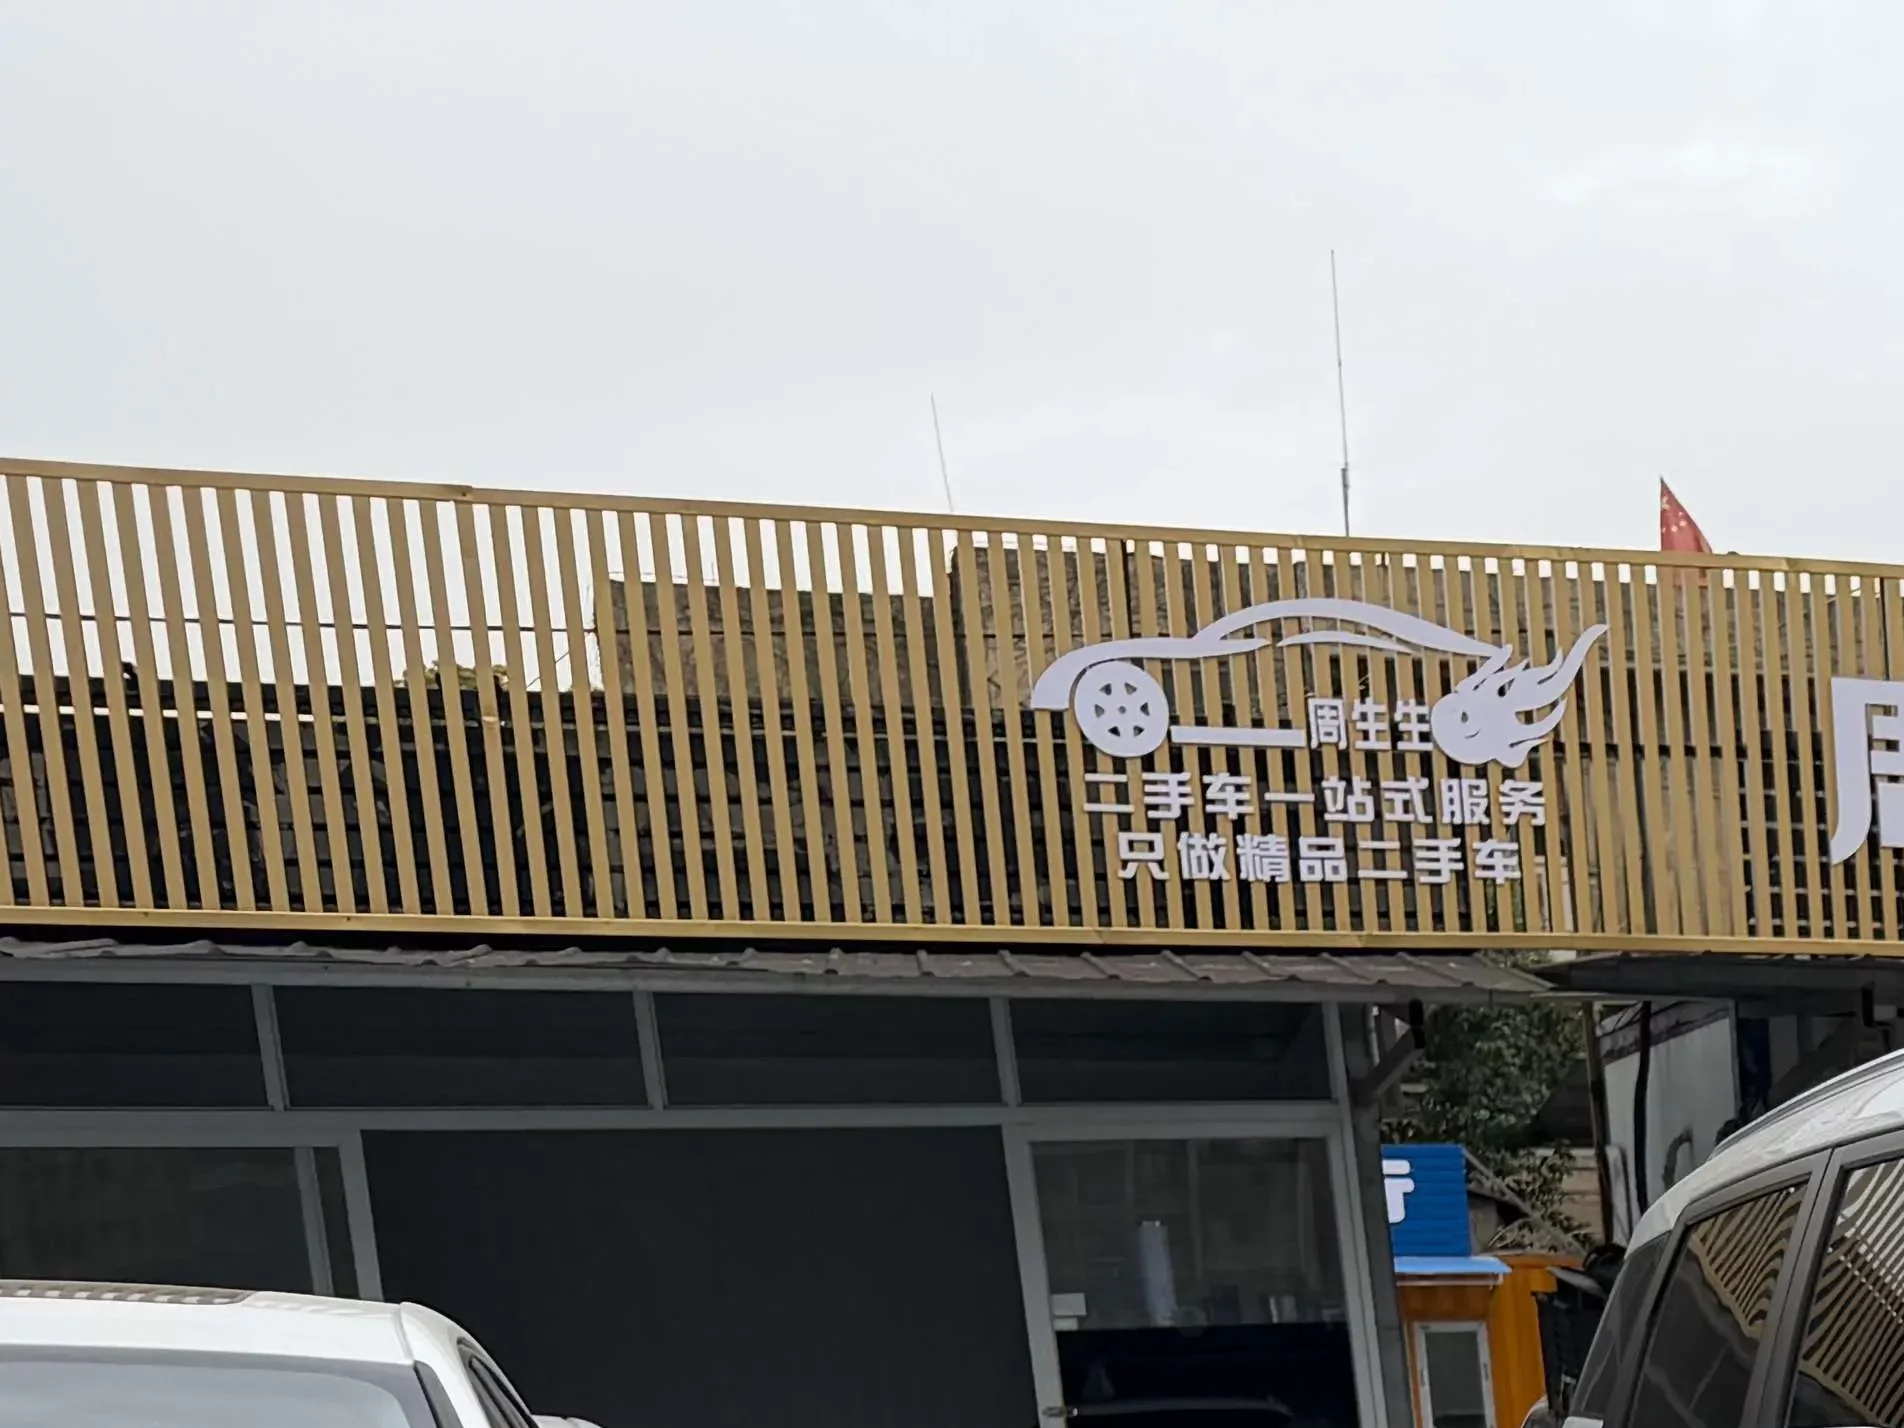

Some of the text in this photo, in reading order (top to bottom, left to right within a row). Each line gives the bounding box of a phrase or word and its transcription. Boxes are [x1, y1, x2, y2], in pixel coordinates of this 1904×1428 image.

[1307, 697, 1431, 752] 周生生
[1083, 771, 1545, 827] 二手车一站式服务
[1117, 831, 1522, 885] 只做精品二手车
